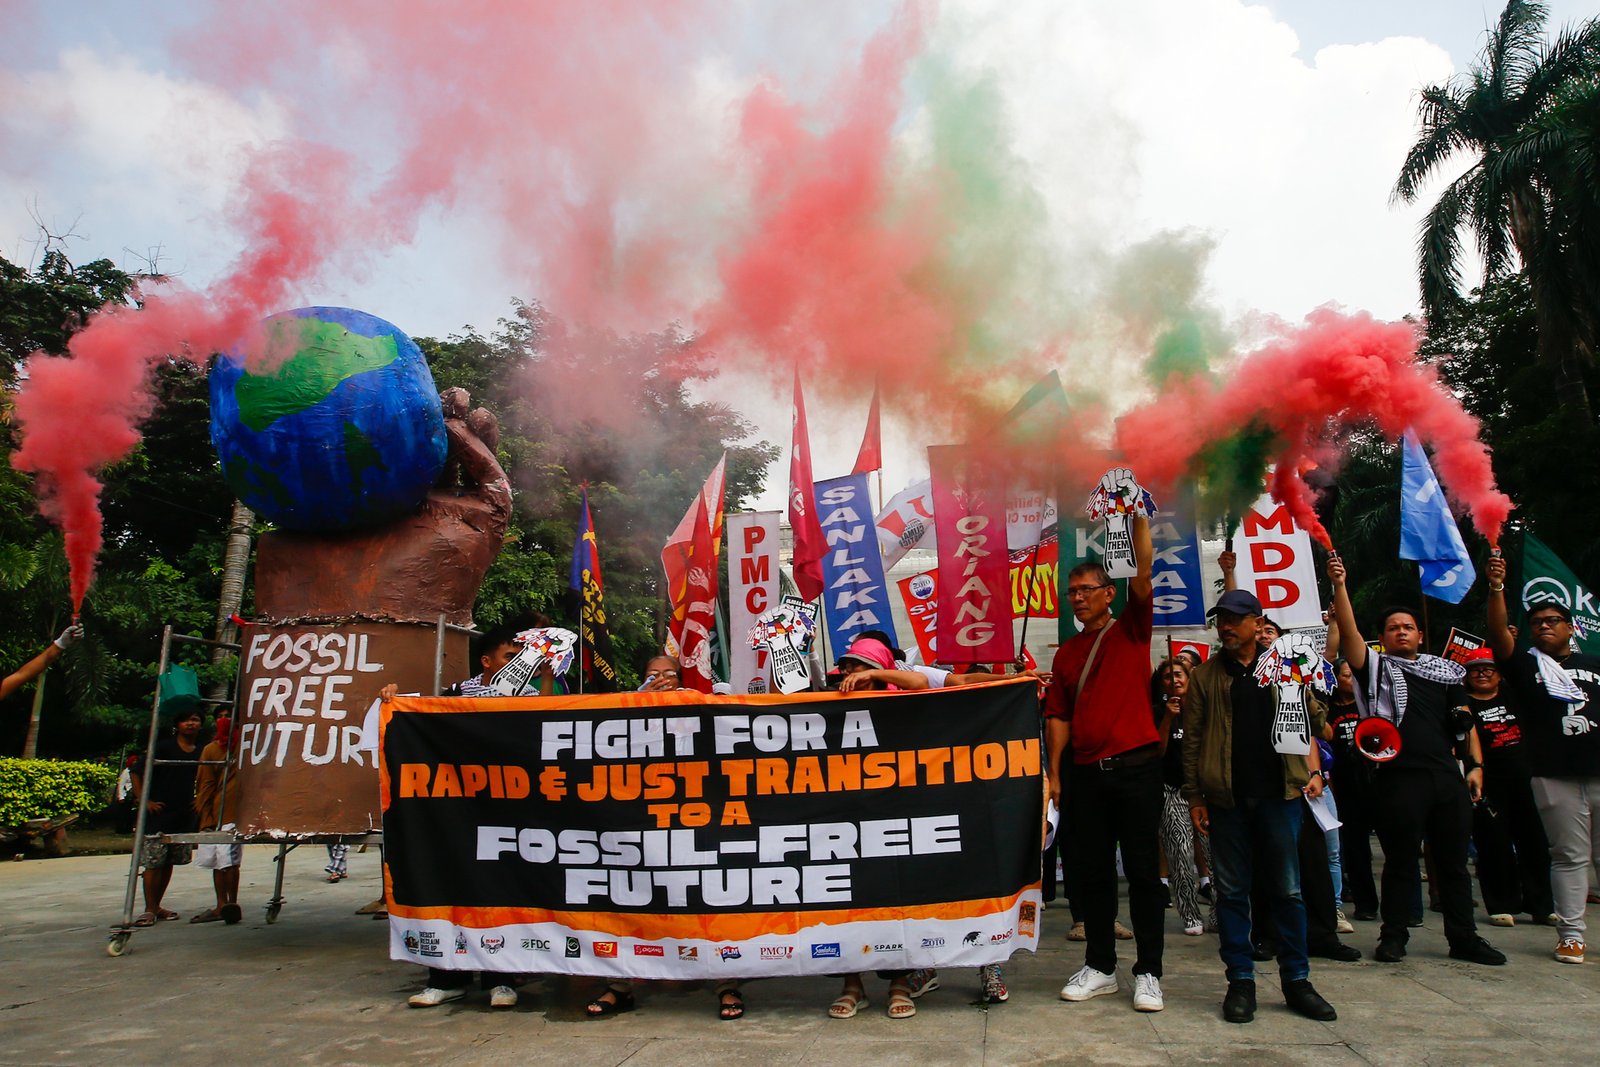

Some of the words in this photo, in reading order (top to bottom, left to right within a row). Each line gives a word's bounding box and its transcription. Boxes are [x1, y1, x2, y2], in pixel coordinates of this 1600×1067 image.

[1108, 530, 1127, 540] TAKE
[1243, 473, 1300, 610] MDD
[1107, 540, 1130, 550] THEM
[1107, 551, 1113, 559] TO
[1151, 512, 1191, 614] AKAS
[1453, 635, 1463, 645] NO
[245, 632, 384, 674] FOSSIL
[774, 645, 793, 658] TAKE
[515, 658, 532, 673] TAKE
[775, 653, 797, 667] THEM
[507, 664, 528, 681] THEM
[776, 667, 783, 676] TO
[247, 675, 353, 720] FREE
[1280, 702, 1302, 711] TAKE
[1279, 712, 1304, 722] THEM
[541, 716, 701, 760] FIGHT
[714, 713, 827, 755] FOR
[840, 709, 879, 749] A
[1277, 723, 1284, 732] TO
[399, 763, 530, 799] RAPID
[538, 765, 567, 801] &
[577, 761, 709, 801] JUST
[720, 738, 1041, 796] TRANSITION
[648, 802, 712, 828] TO
[720, 801, 751, 826] A
[476, 814, 962, 867] FOSSIL-FREE
[564, 863, 852, 907] FUTURE
[531, 939, 550, 950] FDC
